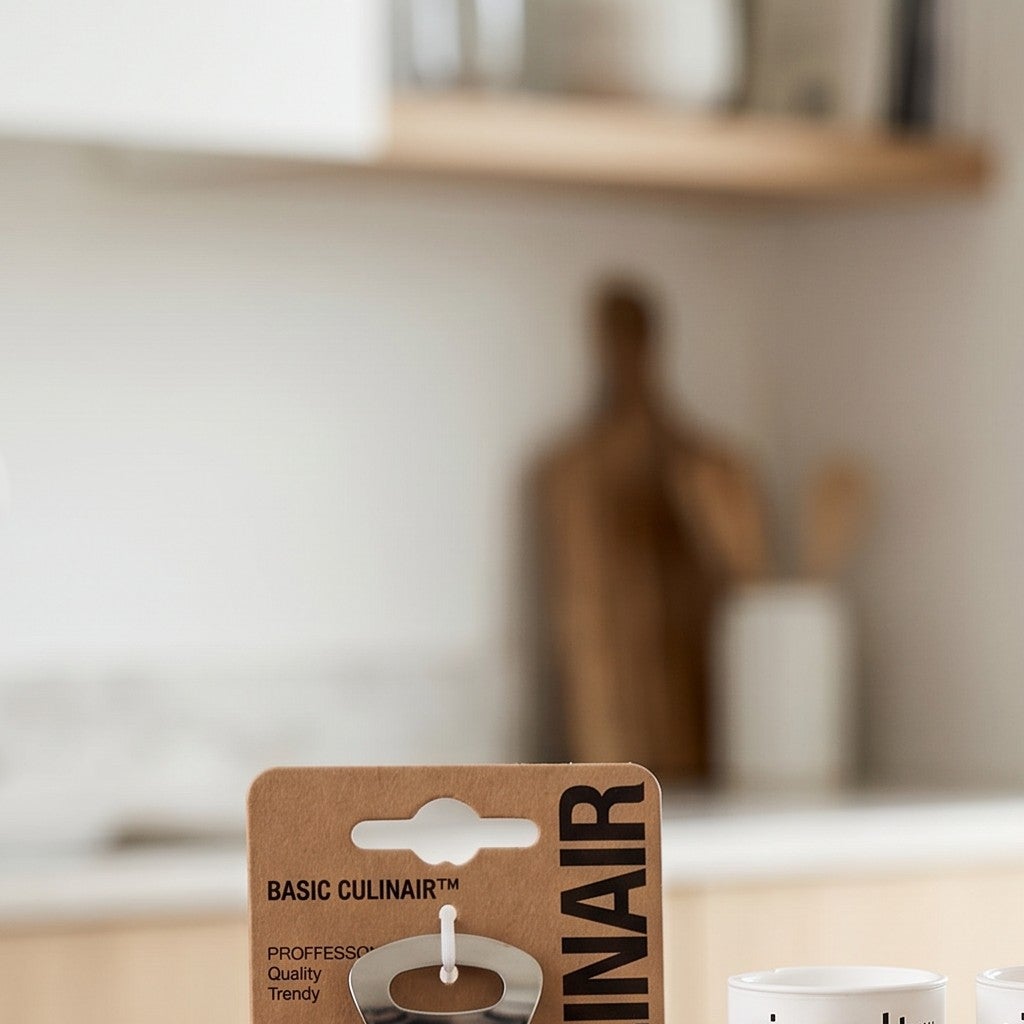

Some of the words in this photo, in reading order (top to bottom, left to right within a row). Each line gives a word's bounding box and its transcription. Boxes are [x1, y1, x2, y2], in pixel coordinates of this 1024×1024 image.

[268, 880, 331, 901] BASIC
[268, 945, 375, 960] PROFFESSO
[268, 966, 322, 984] Quality
[268, 986, 320, 1003] Trendy
